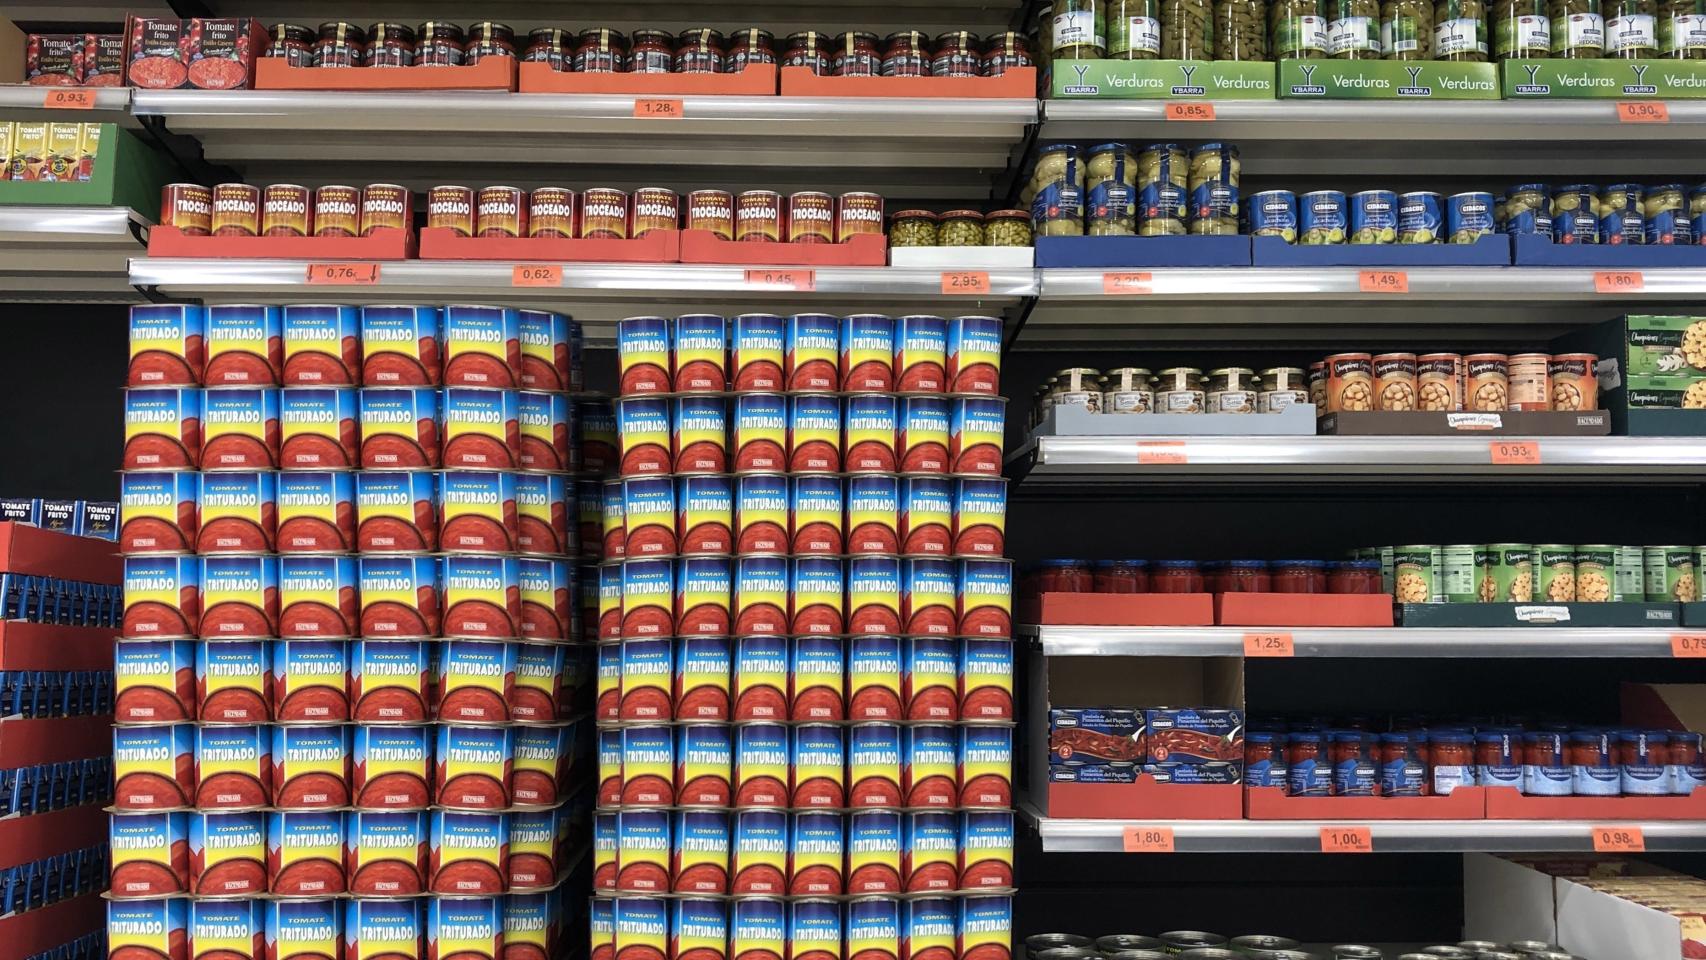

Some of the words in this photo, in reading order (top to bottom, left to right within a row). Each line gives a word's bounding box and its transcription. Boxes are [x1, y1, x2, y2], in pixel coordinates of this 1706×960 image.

[147, 21, 177, 31] Tomate
[204, 22, 235, 31] Tomate
[153, 31, 169, 39] frito
[211, 31, 227, 39] frito
[42, 39, 71, 48] Tomate
[49, 47, 63, 56] frito
[1106, 74, 1164, 87] Verduras
[1213, 75, 1270, 89] Verduras
[1333, 75, 1390, 88] Verduras
[1439, 76, 1495, 90] Verduras
[1557, 74, 1615, 87] Verduras
[1293, 86, 1324, 94] YBARRA
[215, 200, 255, 213] TROCEADO
[266, 201, 305, 214] TROCEADO
[317, 202, 356, 215] TROCEADO
[364, 200, 403, 213] TROCEADO
[430, 202, 469, 214] TROCEADO
[480, 202, 516, 214] TROCEADO
[531, 204, 570, 217] TROCEADO
[585, 205, 624, 219] TROCEADO
[637, 204, 676, 219] TROCEADO
[691, 207, 731, 219] TROCEADO
[737, 207, 776, 219] TROCEADO
[1462, 205, 1486, 213] CIDACOS
[792, 208, 832, 220] TROCEADO
[842, 209, 881, 222] TROCEADO
[132, 327, 179, 339] TRITURADO
[288, 328, 336, 339] TRITURADO
[452, 328, 501, 341] TRITURADO
[623, 341, 665, 353] TRITURADO
[741, 338, 782, 350] TRITURADO
[854, 338, 892, 350] TRITURADO
[208, 410, 260, 423] TRITURADO
[364, 411, 412, 423] TRITURADO
[683, 419, 724, 430] TRITURADO
[797, 417, 837, 430] TRITURADO
[124, 493, 171, 506] TRITURADO
[281, 493, 331, 506] TRITURADO
[447, 491, 498, 505] TRITURADO
[744, 498, 785, 510] TRITURADO
[44, 504, 73, 512] TOMATE
[86, 506, 115, 514] TOMATE
[629, 501, 672, 514] TRITURADO
[853, 499, 895, 512] TRITURADO
[963, 501, 1004, 513] TRITURADO
[90, 513, 111, 521] FRITO
[207, 578, 259, 591] TRITURADO
[362, 578, 411, 591] TRITURADO
[688, 580, 729, 593] TRITURADO
[799, 581, 841, 593] TRITURADO
[915, 581, 955, 594] TRITURADO
[119, 661, 170, 674] TRITURADO
[290, 661, 342, 675] TRITURADO
[450, 661, 501, 676] TRITURADO
[626, 661, 669, 674] TRITURADO
[742, 660, 785, 673] TRITURADO
[854, 661, 897, 673] TRITURADO
[969, 661, 1011, 674] TRITURADO
[203, 748, 255, 761] TRITURADO
[370, 747, 422, 761] TRITURADO
[689, 751, 730, 764] TRITURADO
[915, 751, 955, 764] TRITURADO
[1063, 747, 1069, 756] 2
[1158, 749, 1164, 757] 2
[799, 752, 841, 765] TRITURADO
[114, 835, 165, 848] TRITURADO
[286, 833, 339, 847] TRITURADO
[445, 834, 497, 849] TRITURADO
[622, 837, 667, 850] TRITURADO
[741, 839, 784, 852] TRITURADO
[854, 839, 897, 852] TRITURADO
[969, 836, 1011, 849] TRITURADO
[196, 924, 248, 938] TRITURADO
[362, 925, 413, 941] TRITURADO
[683, 925, 725, 938] TRITURADO
[796, 929, 839, 941] TRITURADO
[914, 924, 955, 936] TRITURADO
